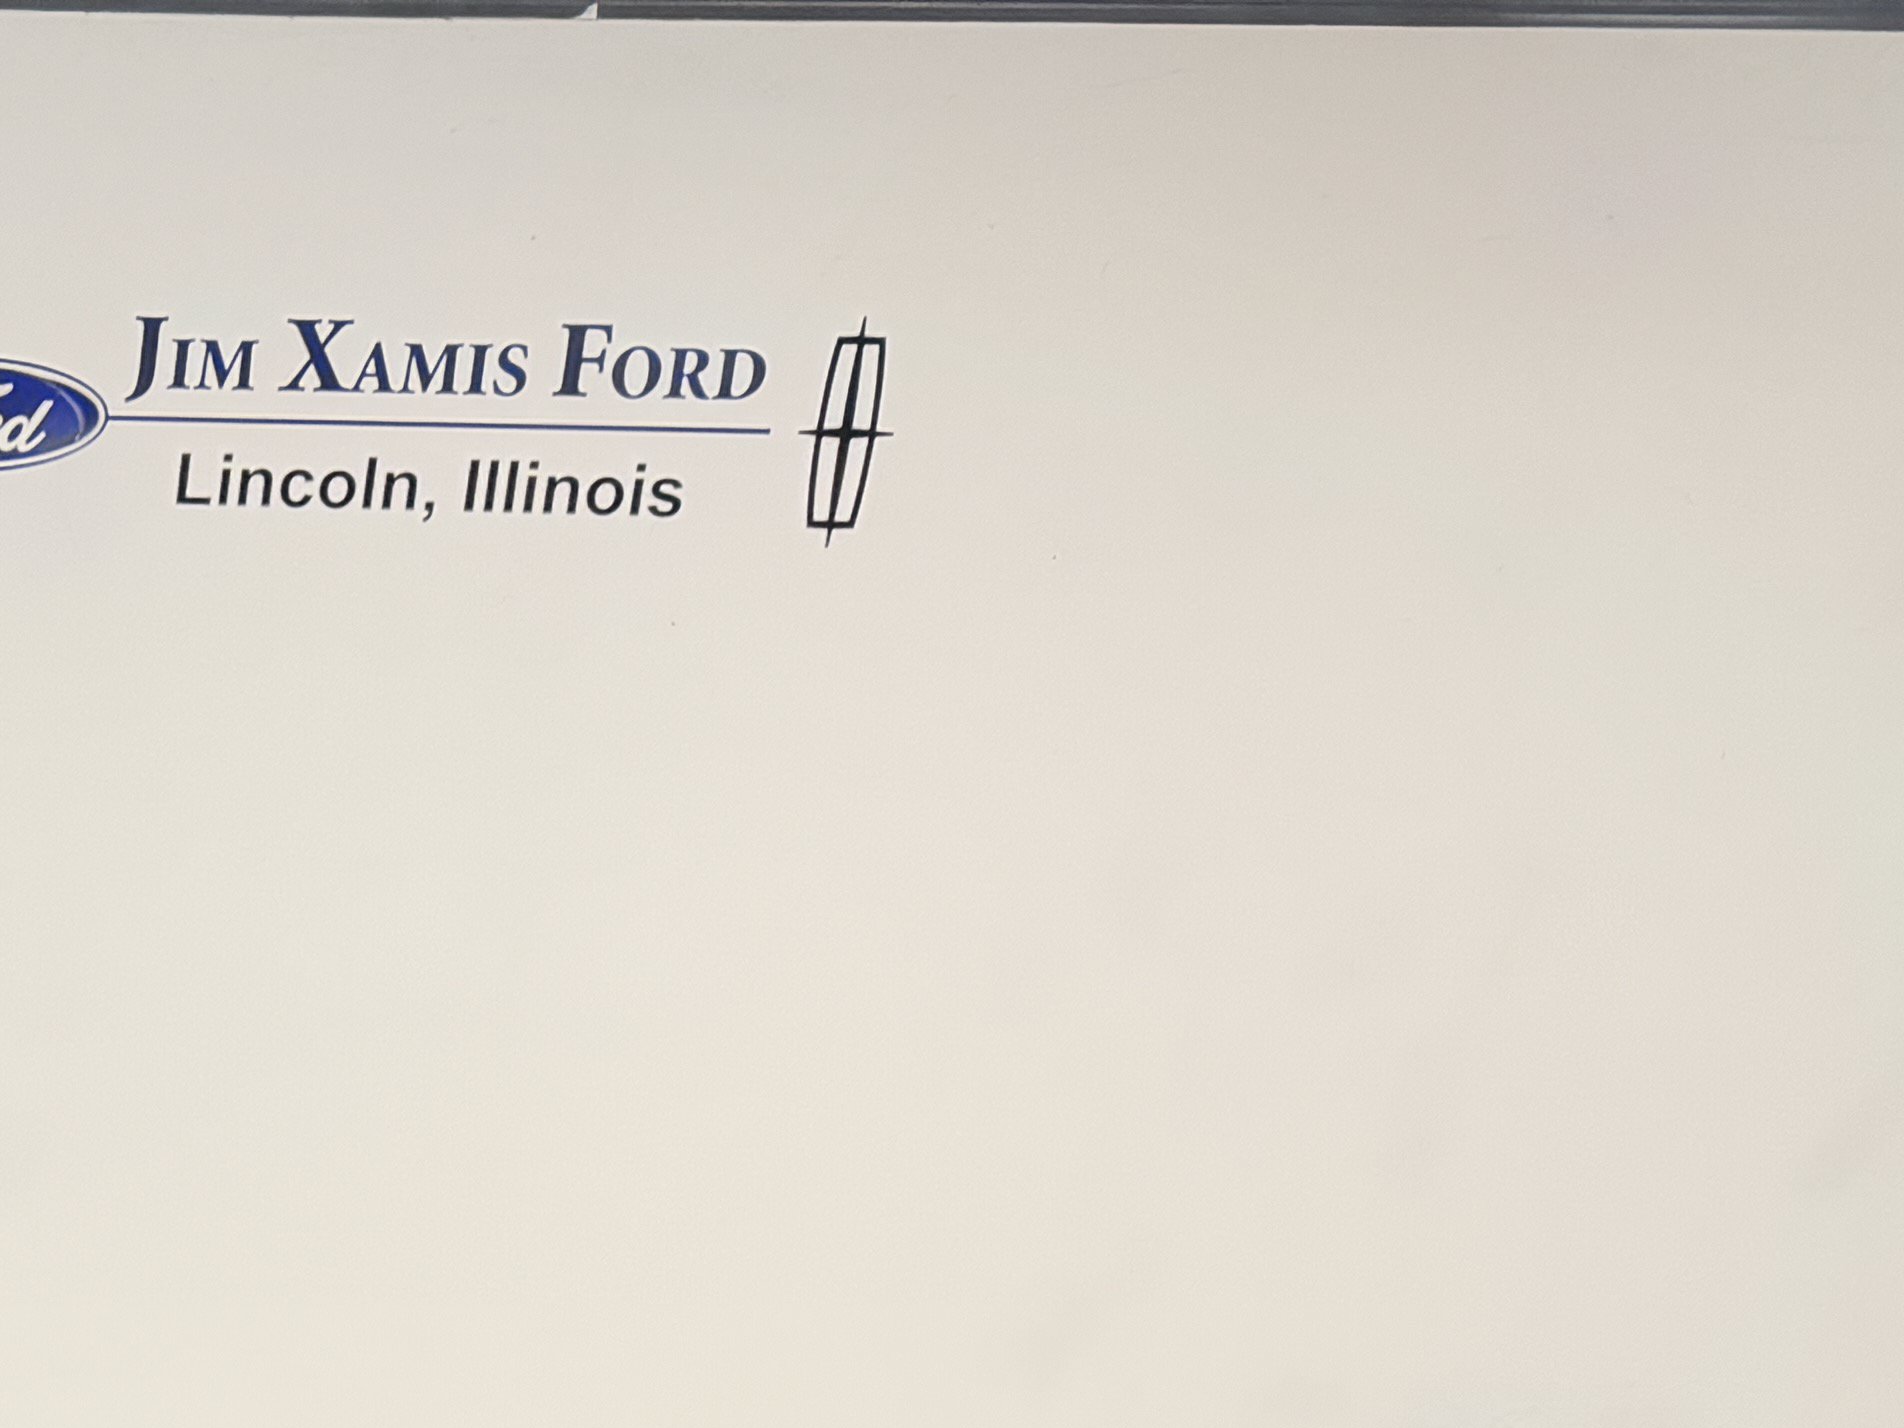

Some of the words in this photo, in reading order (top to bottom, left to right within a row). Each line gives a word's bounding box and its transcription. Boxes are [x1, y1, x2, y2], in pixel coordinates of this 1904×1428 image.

[124, 315, 259, 403] JIM
[277, 318, 529, 397] XAMIS
[552, 323, 767, 400] FORD
[176, 453, 435, 522] Lincoln,
[463, 459, 683, 518] Illinois
